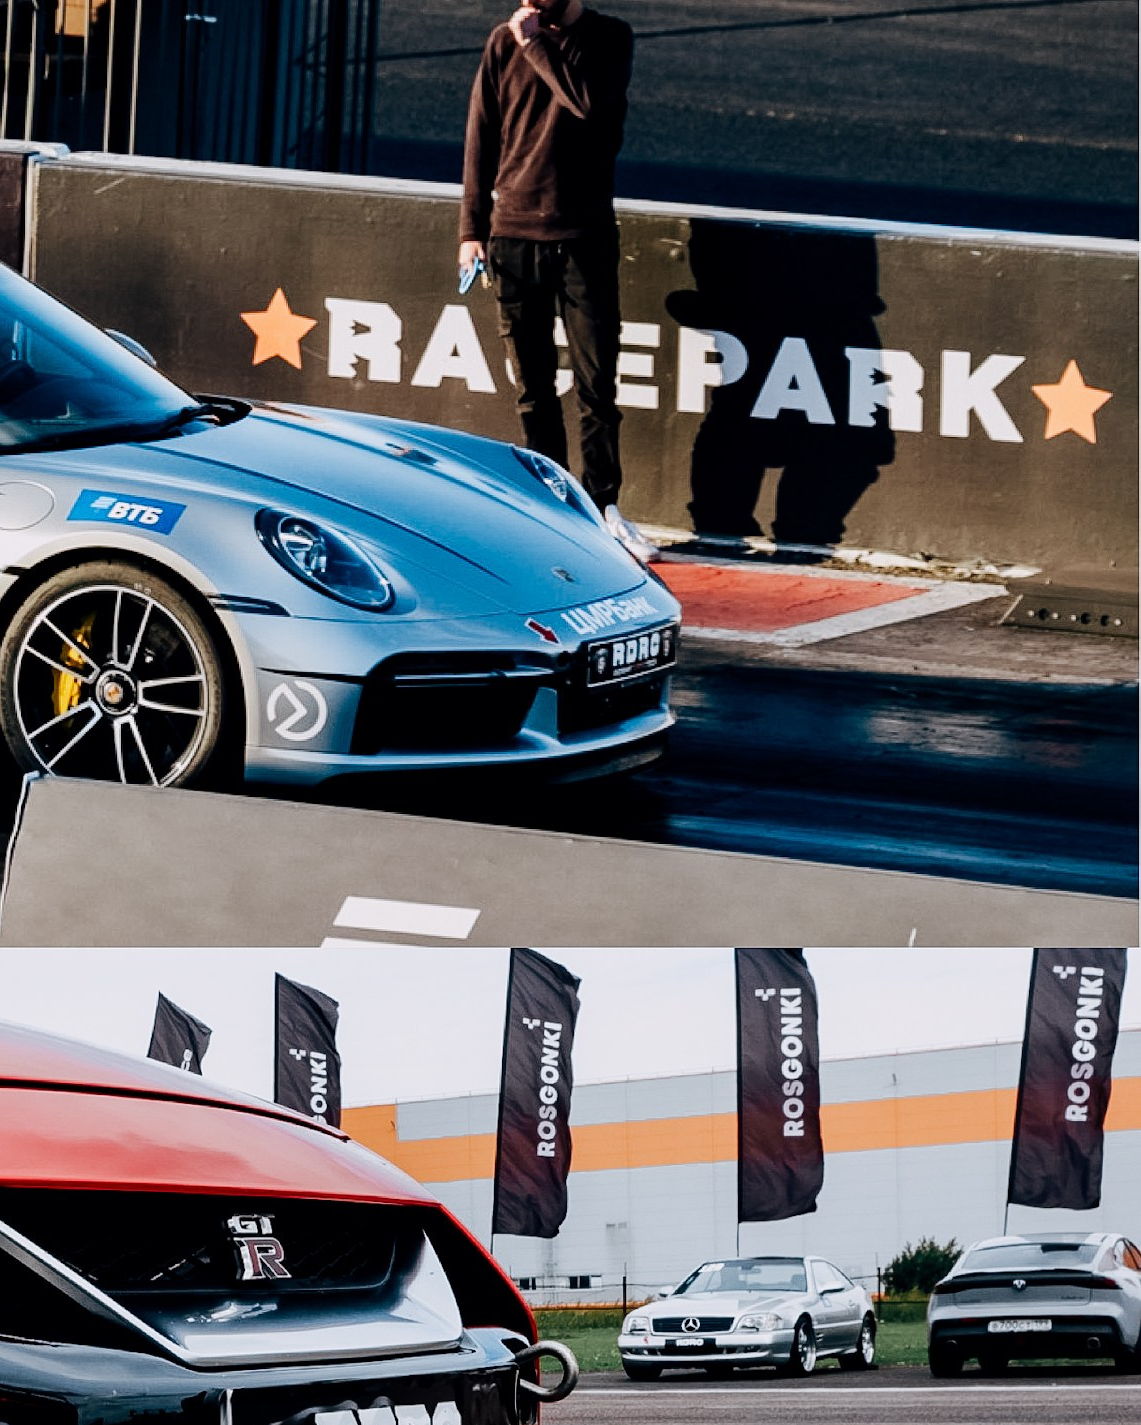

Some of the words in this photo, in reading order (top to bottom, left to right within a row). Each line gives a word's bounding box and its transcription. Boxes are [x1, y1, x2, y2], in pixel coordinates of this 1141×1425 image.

[107, 502, 163, 525] ВТБ
[537, 1022, 562, 1158] ROSGONKI
[780, 988, 804, 1137] ROSGONKI
[1064, 966, 1104, 1122] ROSGONKI
